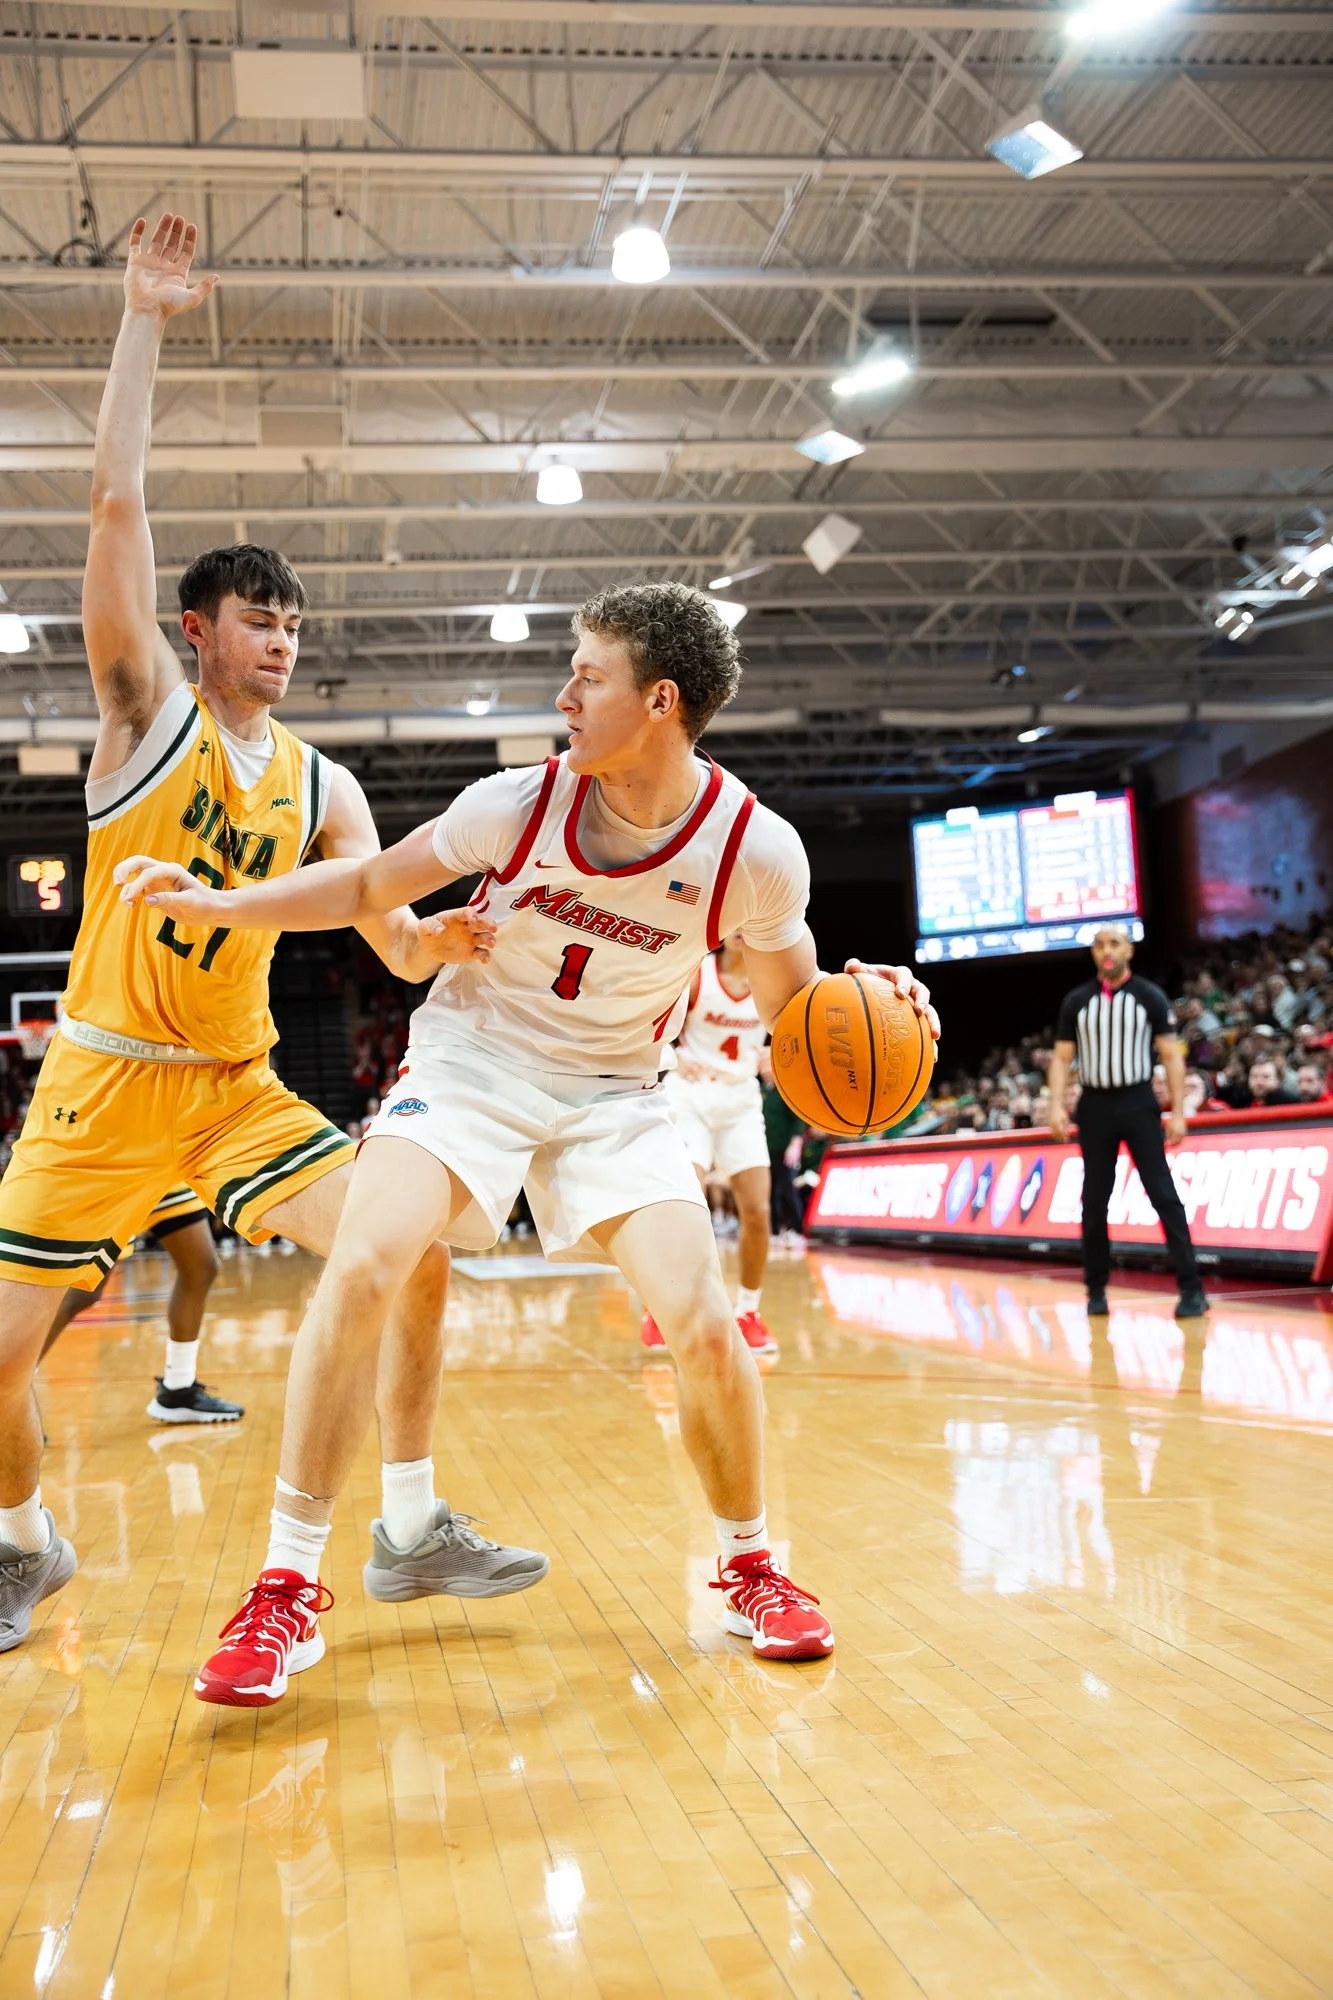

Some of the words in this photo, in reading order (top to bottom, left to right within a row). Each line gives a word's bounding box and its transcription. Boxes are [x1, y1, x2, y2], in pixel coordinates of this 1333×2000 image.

[270, 797, 295, 809] MAAC
[510, 884, 681, 954] MARIST
[551, 942, 594, 1001] 1
[74, 1026, 158, 1057] UNDER
[719, 1034, 739, 1061] 4
[825, 1006, 854, 1069] EVO
[846, 1069, 858, 1092] NXT
